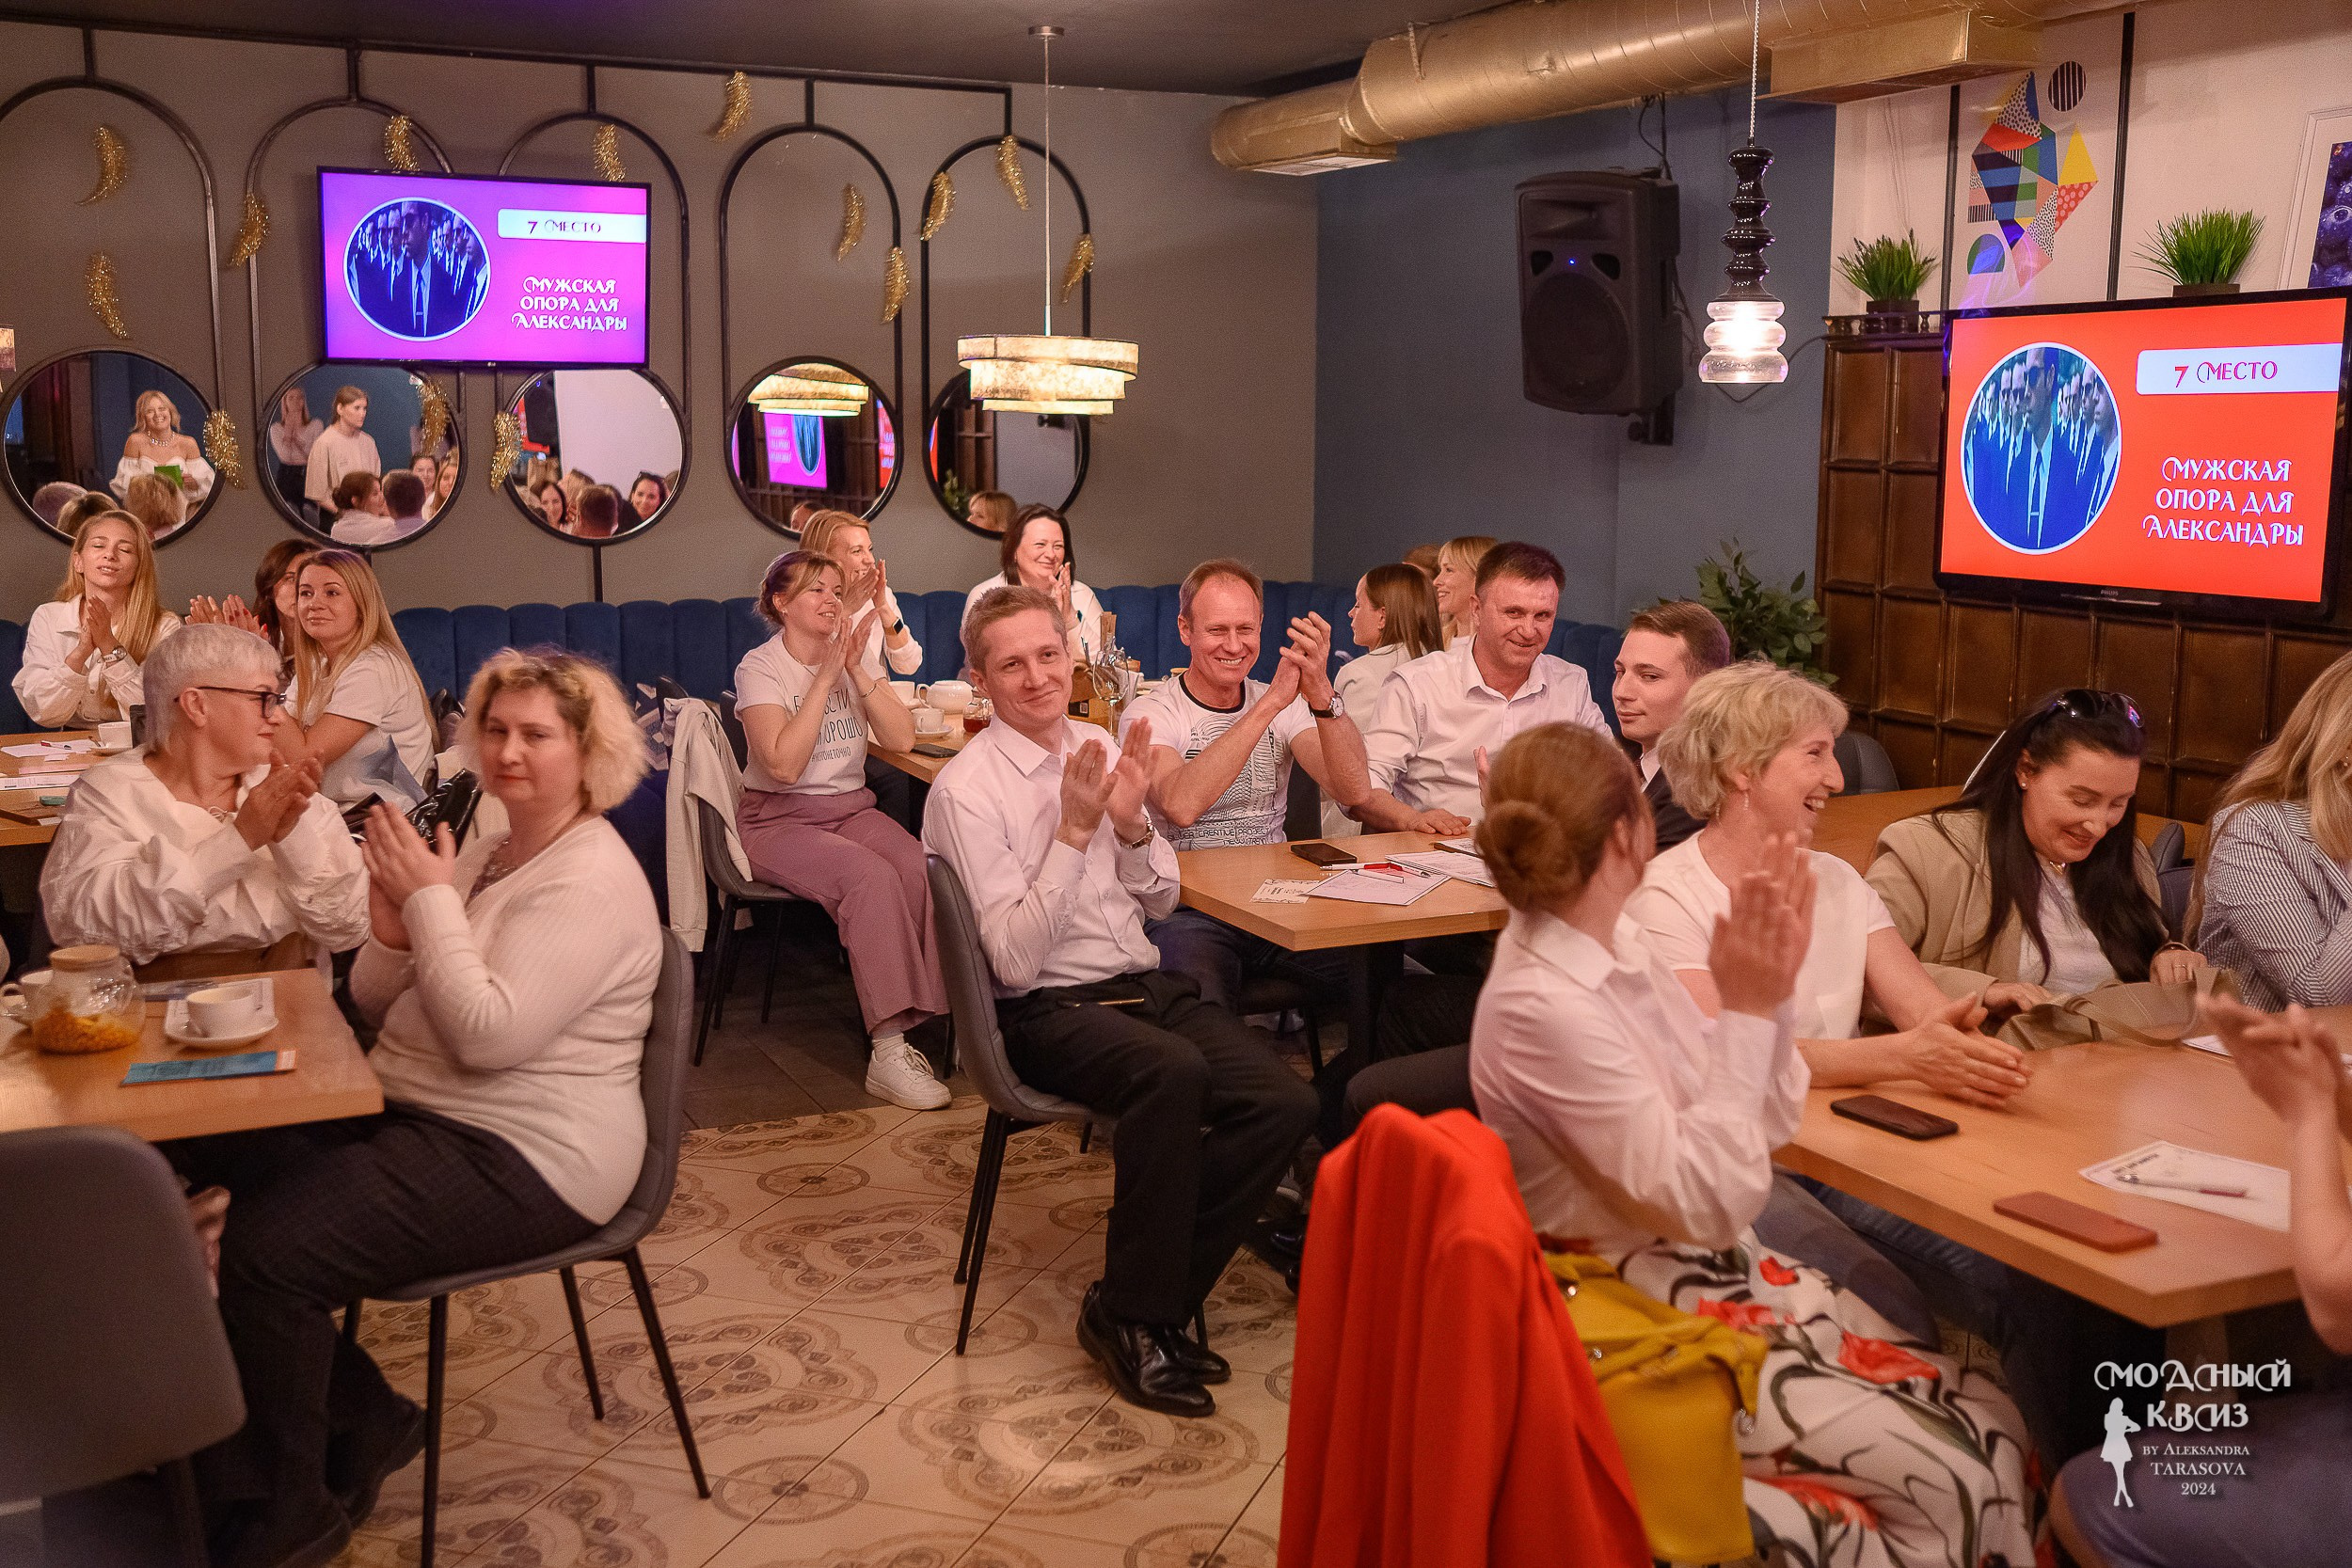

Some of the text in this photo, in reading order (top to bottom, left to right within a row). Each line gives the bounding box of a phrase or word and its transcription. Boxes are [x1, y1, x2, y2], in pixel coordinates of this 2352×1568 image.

[528, 221, 538, 235] 7
[522, 276, 617, 294] МУЖСКАЯ
[519, 295, 620, 314] ОПОРА ДЛЯ
[511, 312, 628, 332] АЛЕКСАНДРЫ
[2174, 365, 2189, 388] 7
[2162, 456, 2293, 482] МУЖСКАЯ
[2155, 487, 2295, 517] ОПОРА ДЛЯ
[2142, 514, 2304, 548] АЛЕКСАНДРЫ
